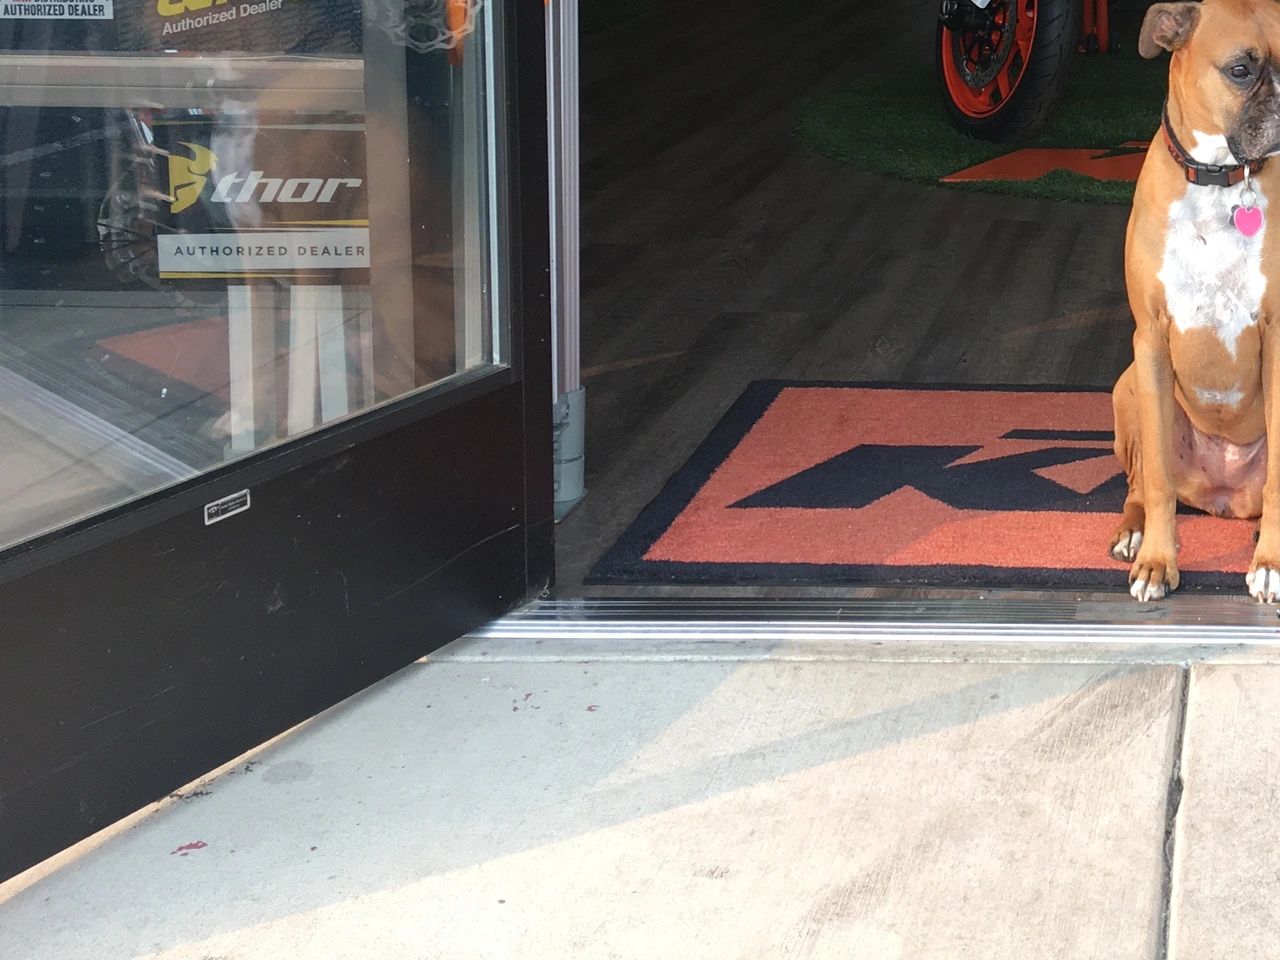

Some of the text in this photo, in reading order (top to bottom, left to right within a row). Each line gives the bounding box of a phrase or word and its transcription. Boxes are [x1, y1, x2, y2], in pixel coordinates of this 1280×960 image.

[3, 4, 105, 16] AUTHORIZED DEALER
[162, 8, 237, 35] Authorized
[210, 170, 362, 203] thor
[174, 246, 365, 257] AUTHORIZED DEALER
